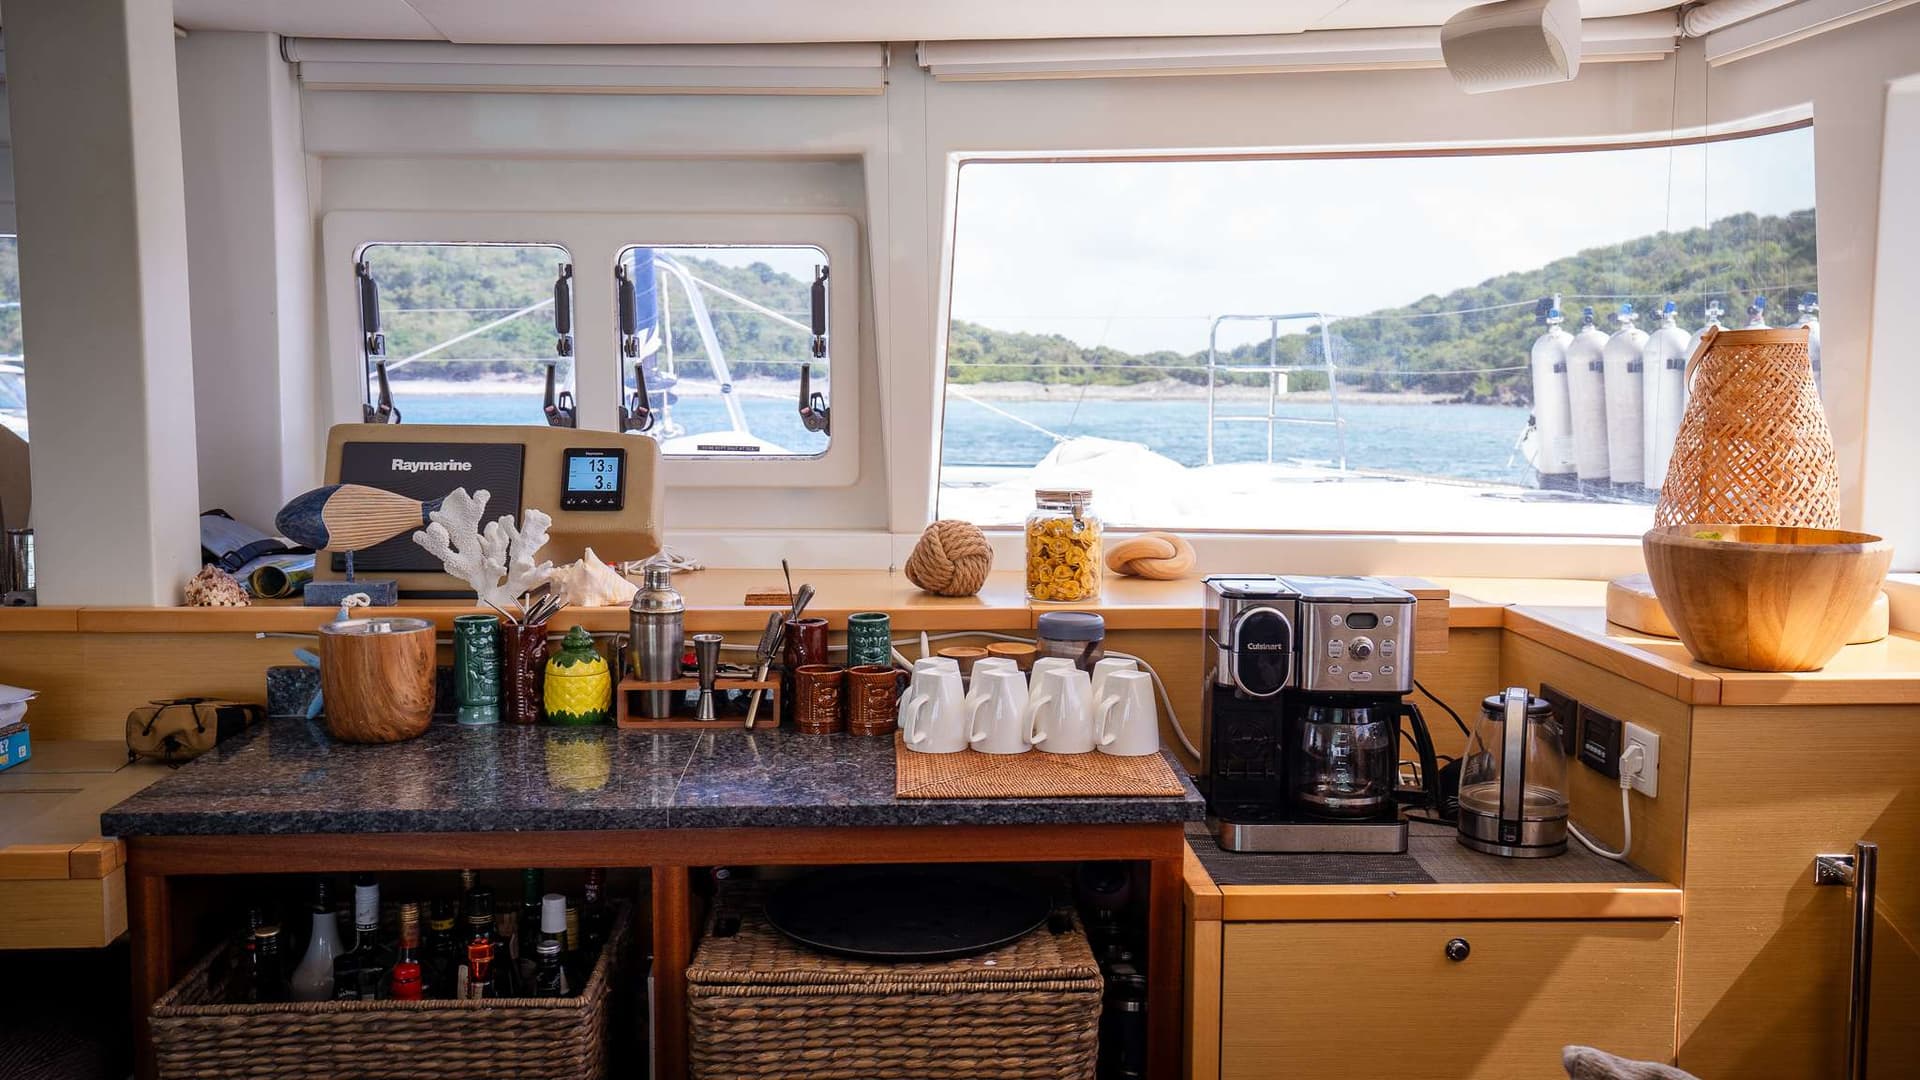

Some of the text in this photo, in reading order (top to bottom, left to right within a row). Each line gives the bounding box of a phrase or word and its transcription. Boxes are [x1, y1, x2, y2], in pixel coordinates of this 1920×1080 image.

[391, 458, 472, 473] Raymarine
[589, 459, 613, 473] 13.3
[594, 475, 612, 490] 3.6
[1247, 642, 1282, 650] Cuisinart
